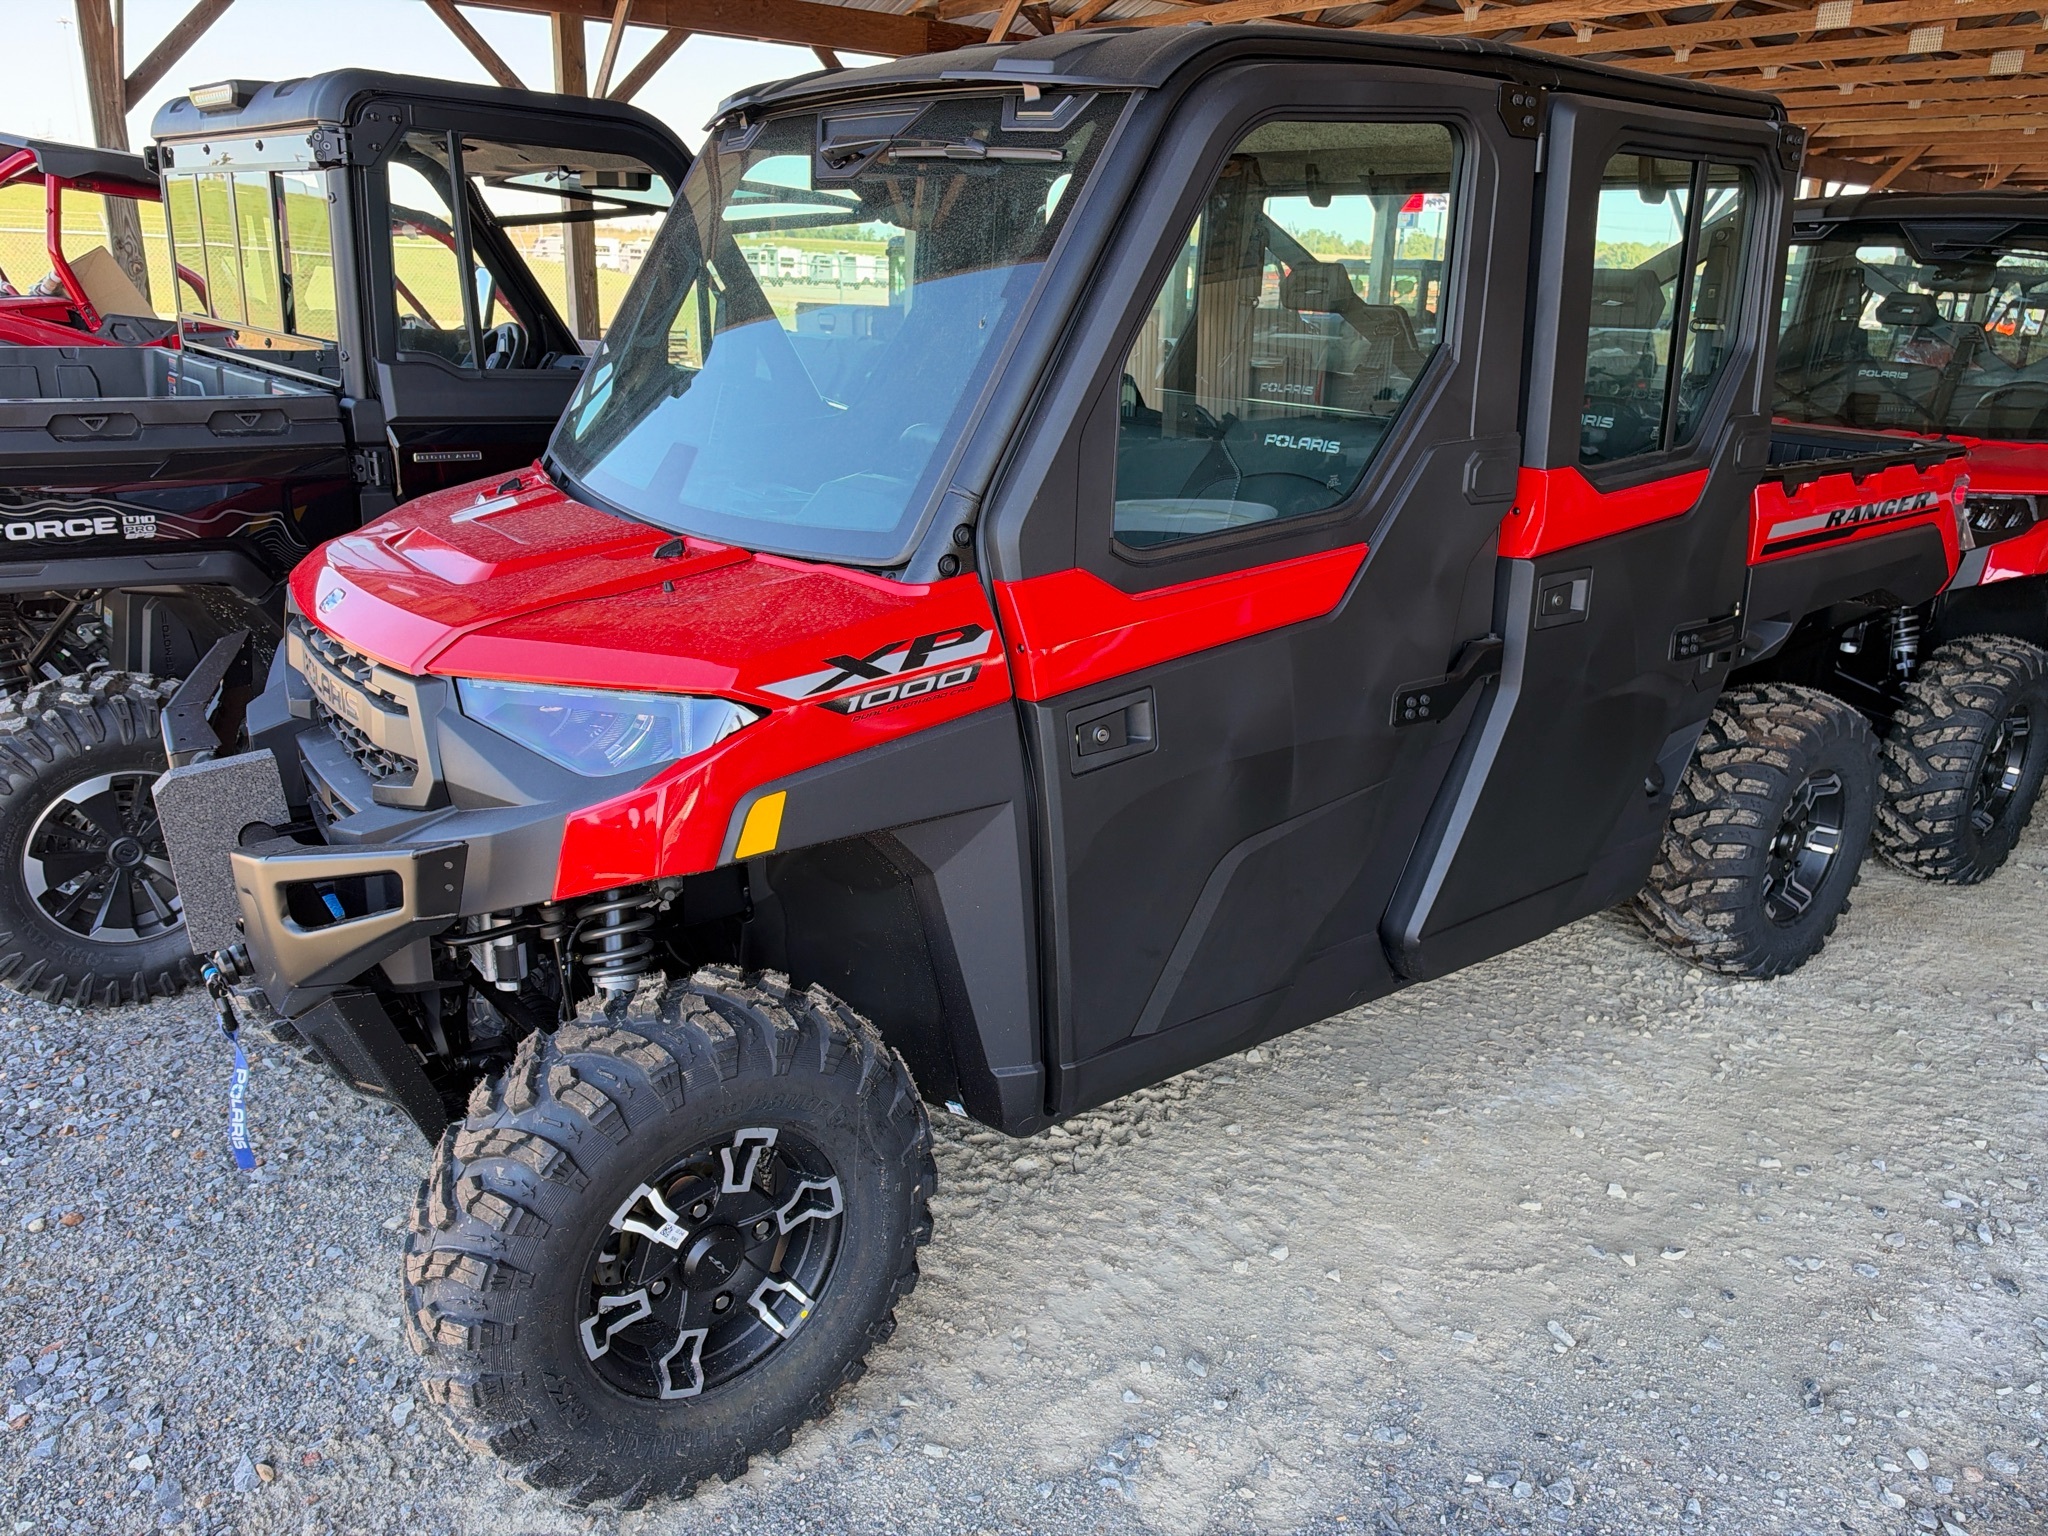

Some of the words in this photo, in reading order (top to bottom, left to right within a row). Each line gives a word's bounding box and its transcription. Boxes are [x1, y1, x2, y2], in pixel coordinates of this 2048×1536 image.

[1260, 382, 1314, 396] POLARIS
[1857, 369, 1909, 380] POLARIS
[1264, 433, 1341, 454] POLARIS
[0, 516, 119, 541] ORCE
[1825, 491, 1931, 529] RANGER
[124, 525, 157, 534] PRO
[803, 623, 986, 697] XP
[303, 648, 360, 721] POLARIS
[846, 666, 972, 714] 1000
[851, 710, 882, 723] DUAL
[887, 692, 948, 712] OVERHEAD
[950, 685, 974, 699] CAM
[229, 1068, 249, 1151] POLARIS
